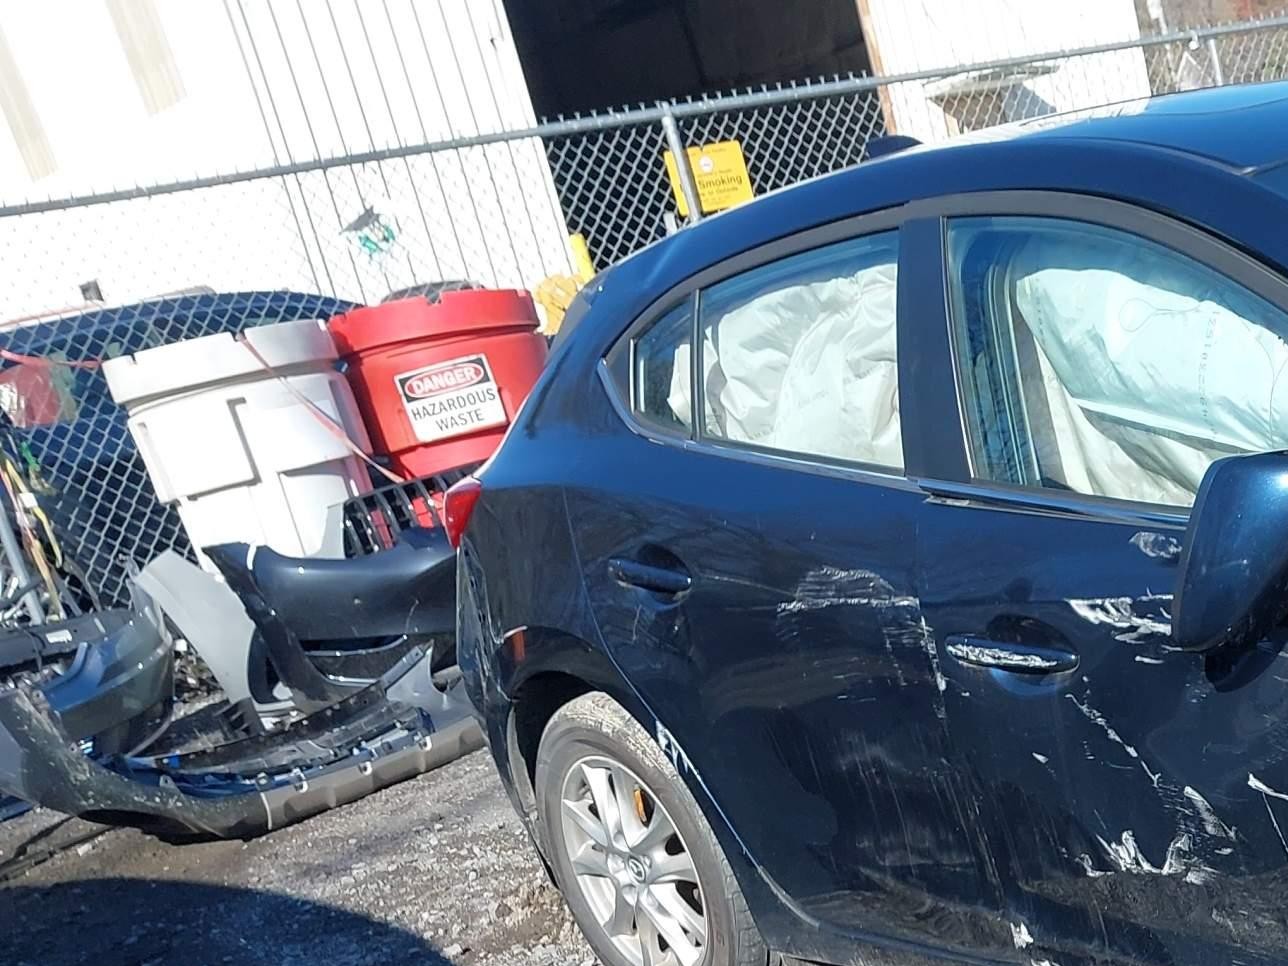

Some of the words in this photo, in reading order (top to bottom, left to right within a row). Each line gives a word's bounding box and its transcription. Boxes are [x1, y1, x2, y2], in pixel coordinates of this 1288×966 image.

[698, 174, 743, 190] Smoking
[412, 366, 477, 395] DANGER
[410, 387, 497, 422] HAZARDOUS
[435, 408, 486, 432] WASTE
